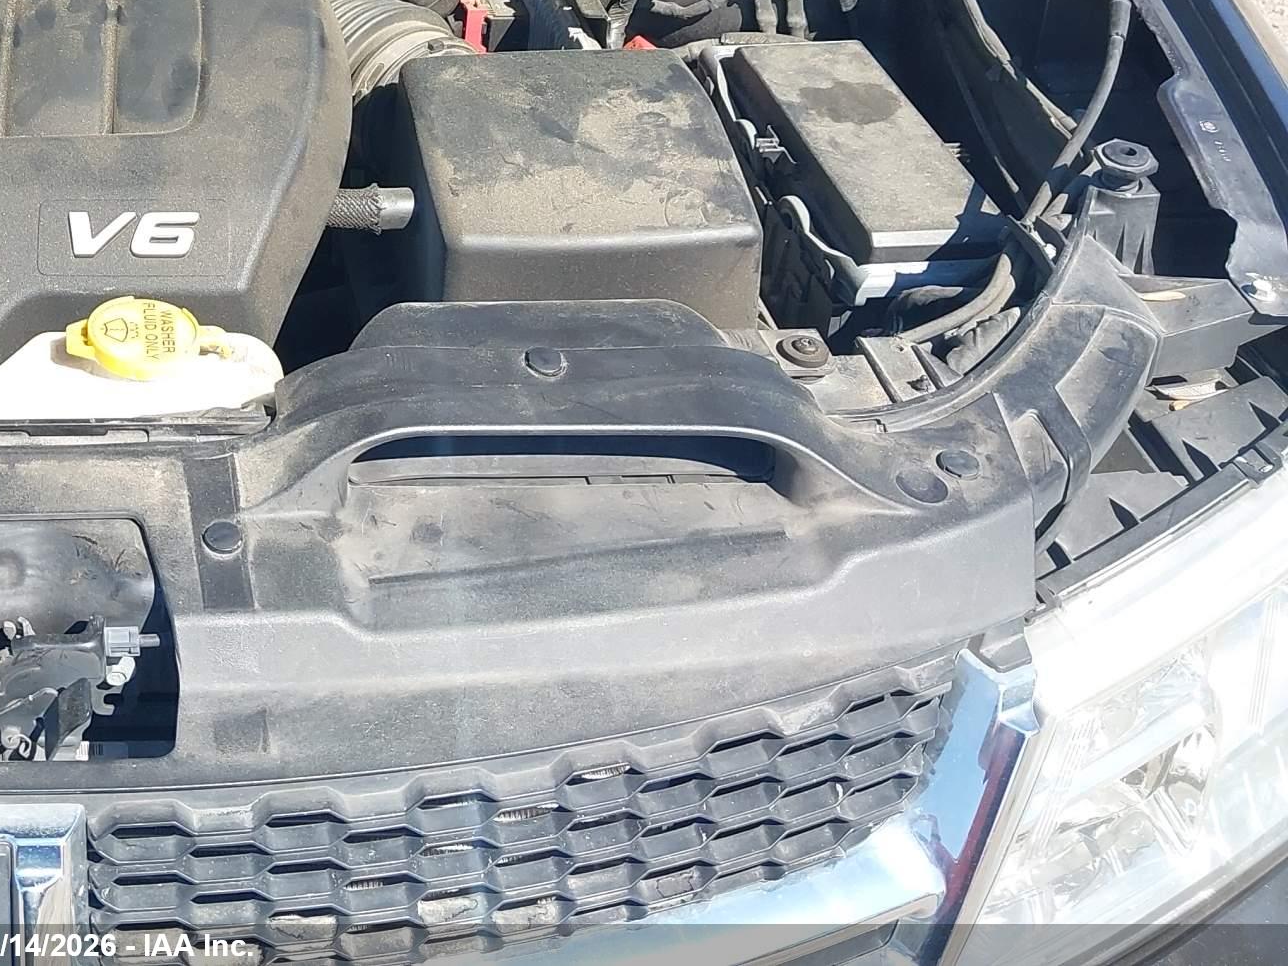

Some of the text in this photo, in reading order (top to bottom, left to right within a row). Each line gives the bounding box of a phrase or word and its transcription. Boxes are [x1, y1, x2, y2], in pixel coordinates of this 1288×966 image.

[68, 211, 200, 258] V6
[143, 302, 161, 361] FLUID ONLY
[159, 309, 176, 353] WASHER
